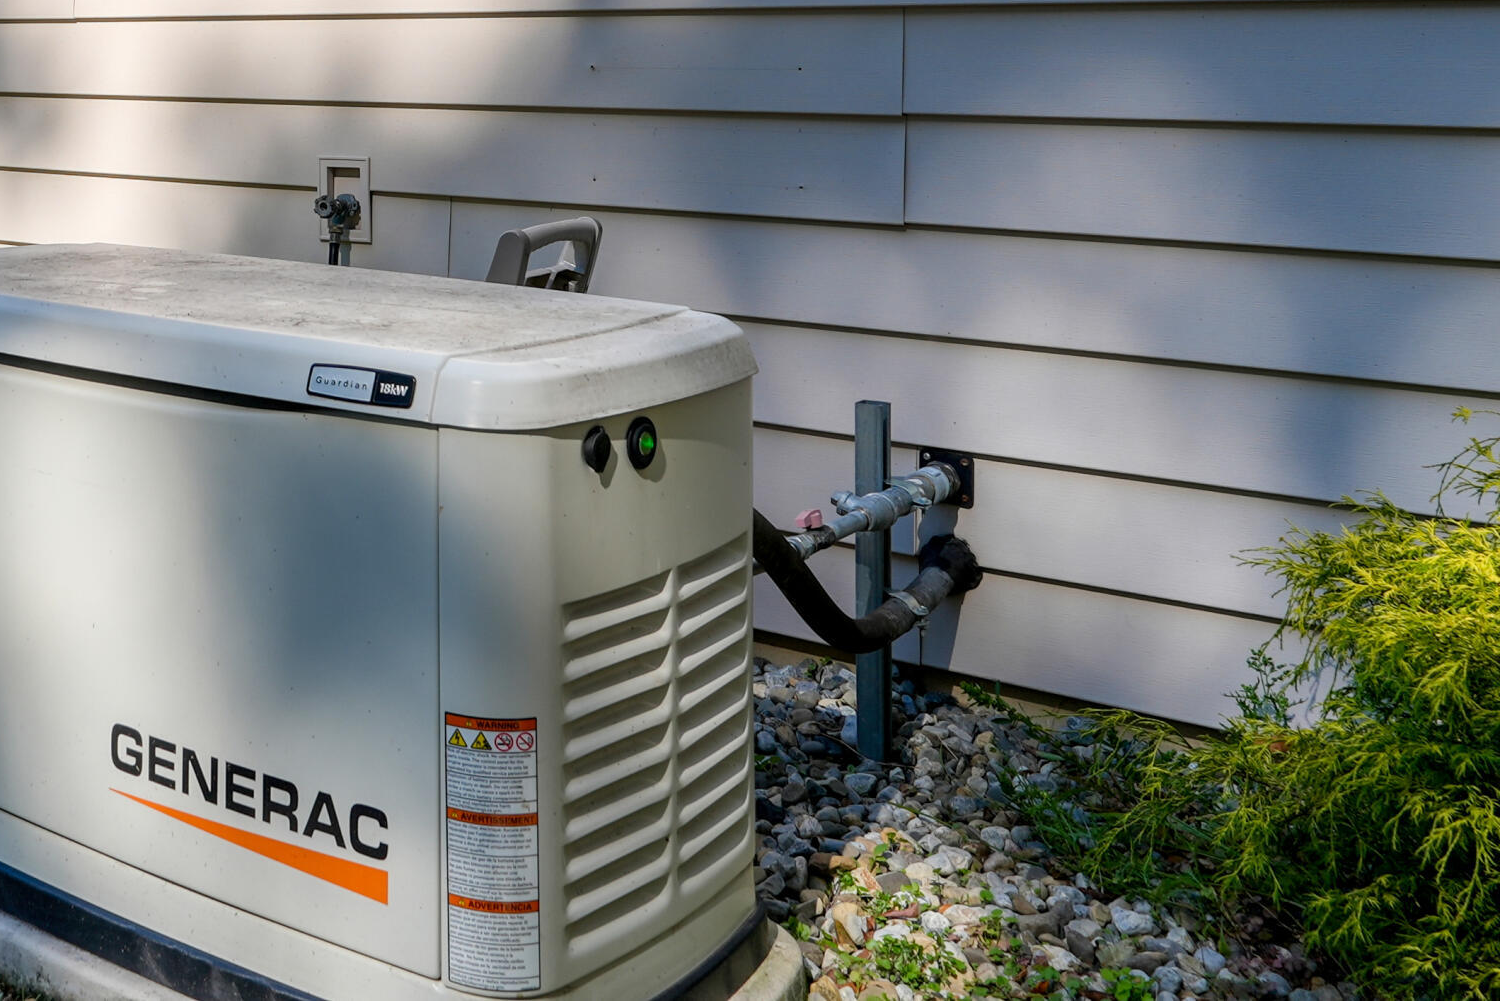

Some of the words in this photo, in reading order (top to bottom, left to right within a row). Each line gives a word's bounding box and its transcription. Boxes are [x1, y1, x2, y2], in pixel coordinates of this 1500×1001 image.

[315, 375, 368, 390] Guardian
[380, 382, 409, 397] 18kW
[476, 719, 519, 730] WARNING
[111, 723, 389, 860] GENERAC
[460, 812, 534, 825] AVERTISSEMENT
[468, 900, 533, 911] ADVERTENCIA
